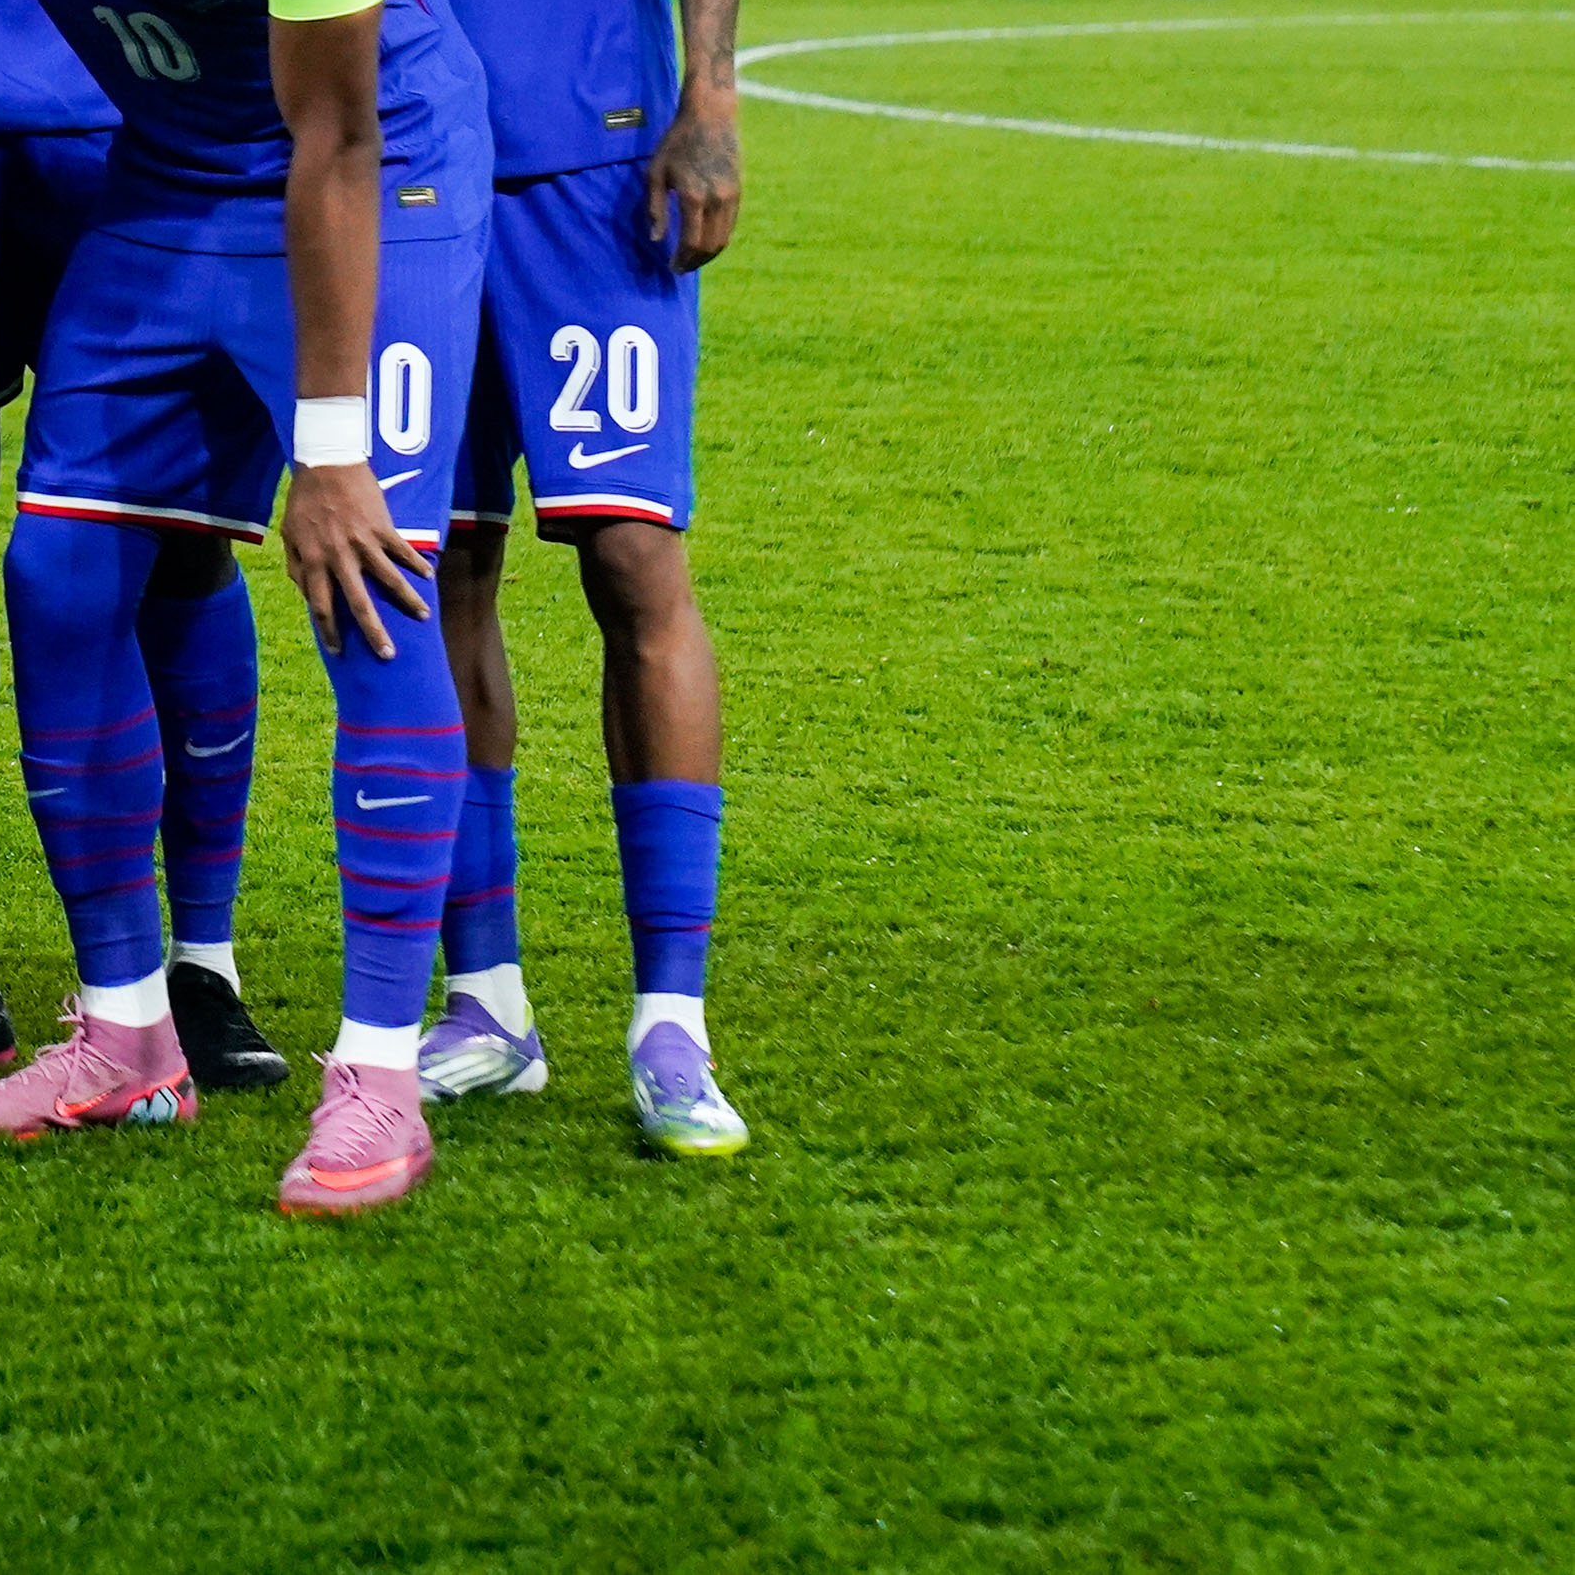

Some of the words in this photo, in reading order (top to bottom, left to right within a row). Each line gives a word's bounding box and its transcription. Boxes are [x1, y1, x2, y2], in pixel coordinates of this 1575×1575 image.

[91, 4, 202, 82] 10
[366, 341, 433, 457] 0
[549, 323, 660, 434] 20
